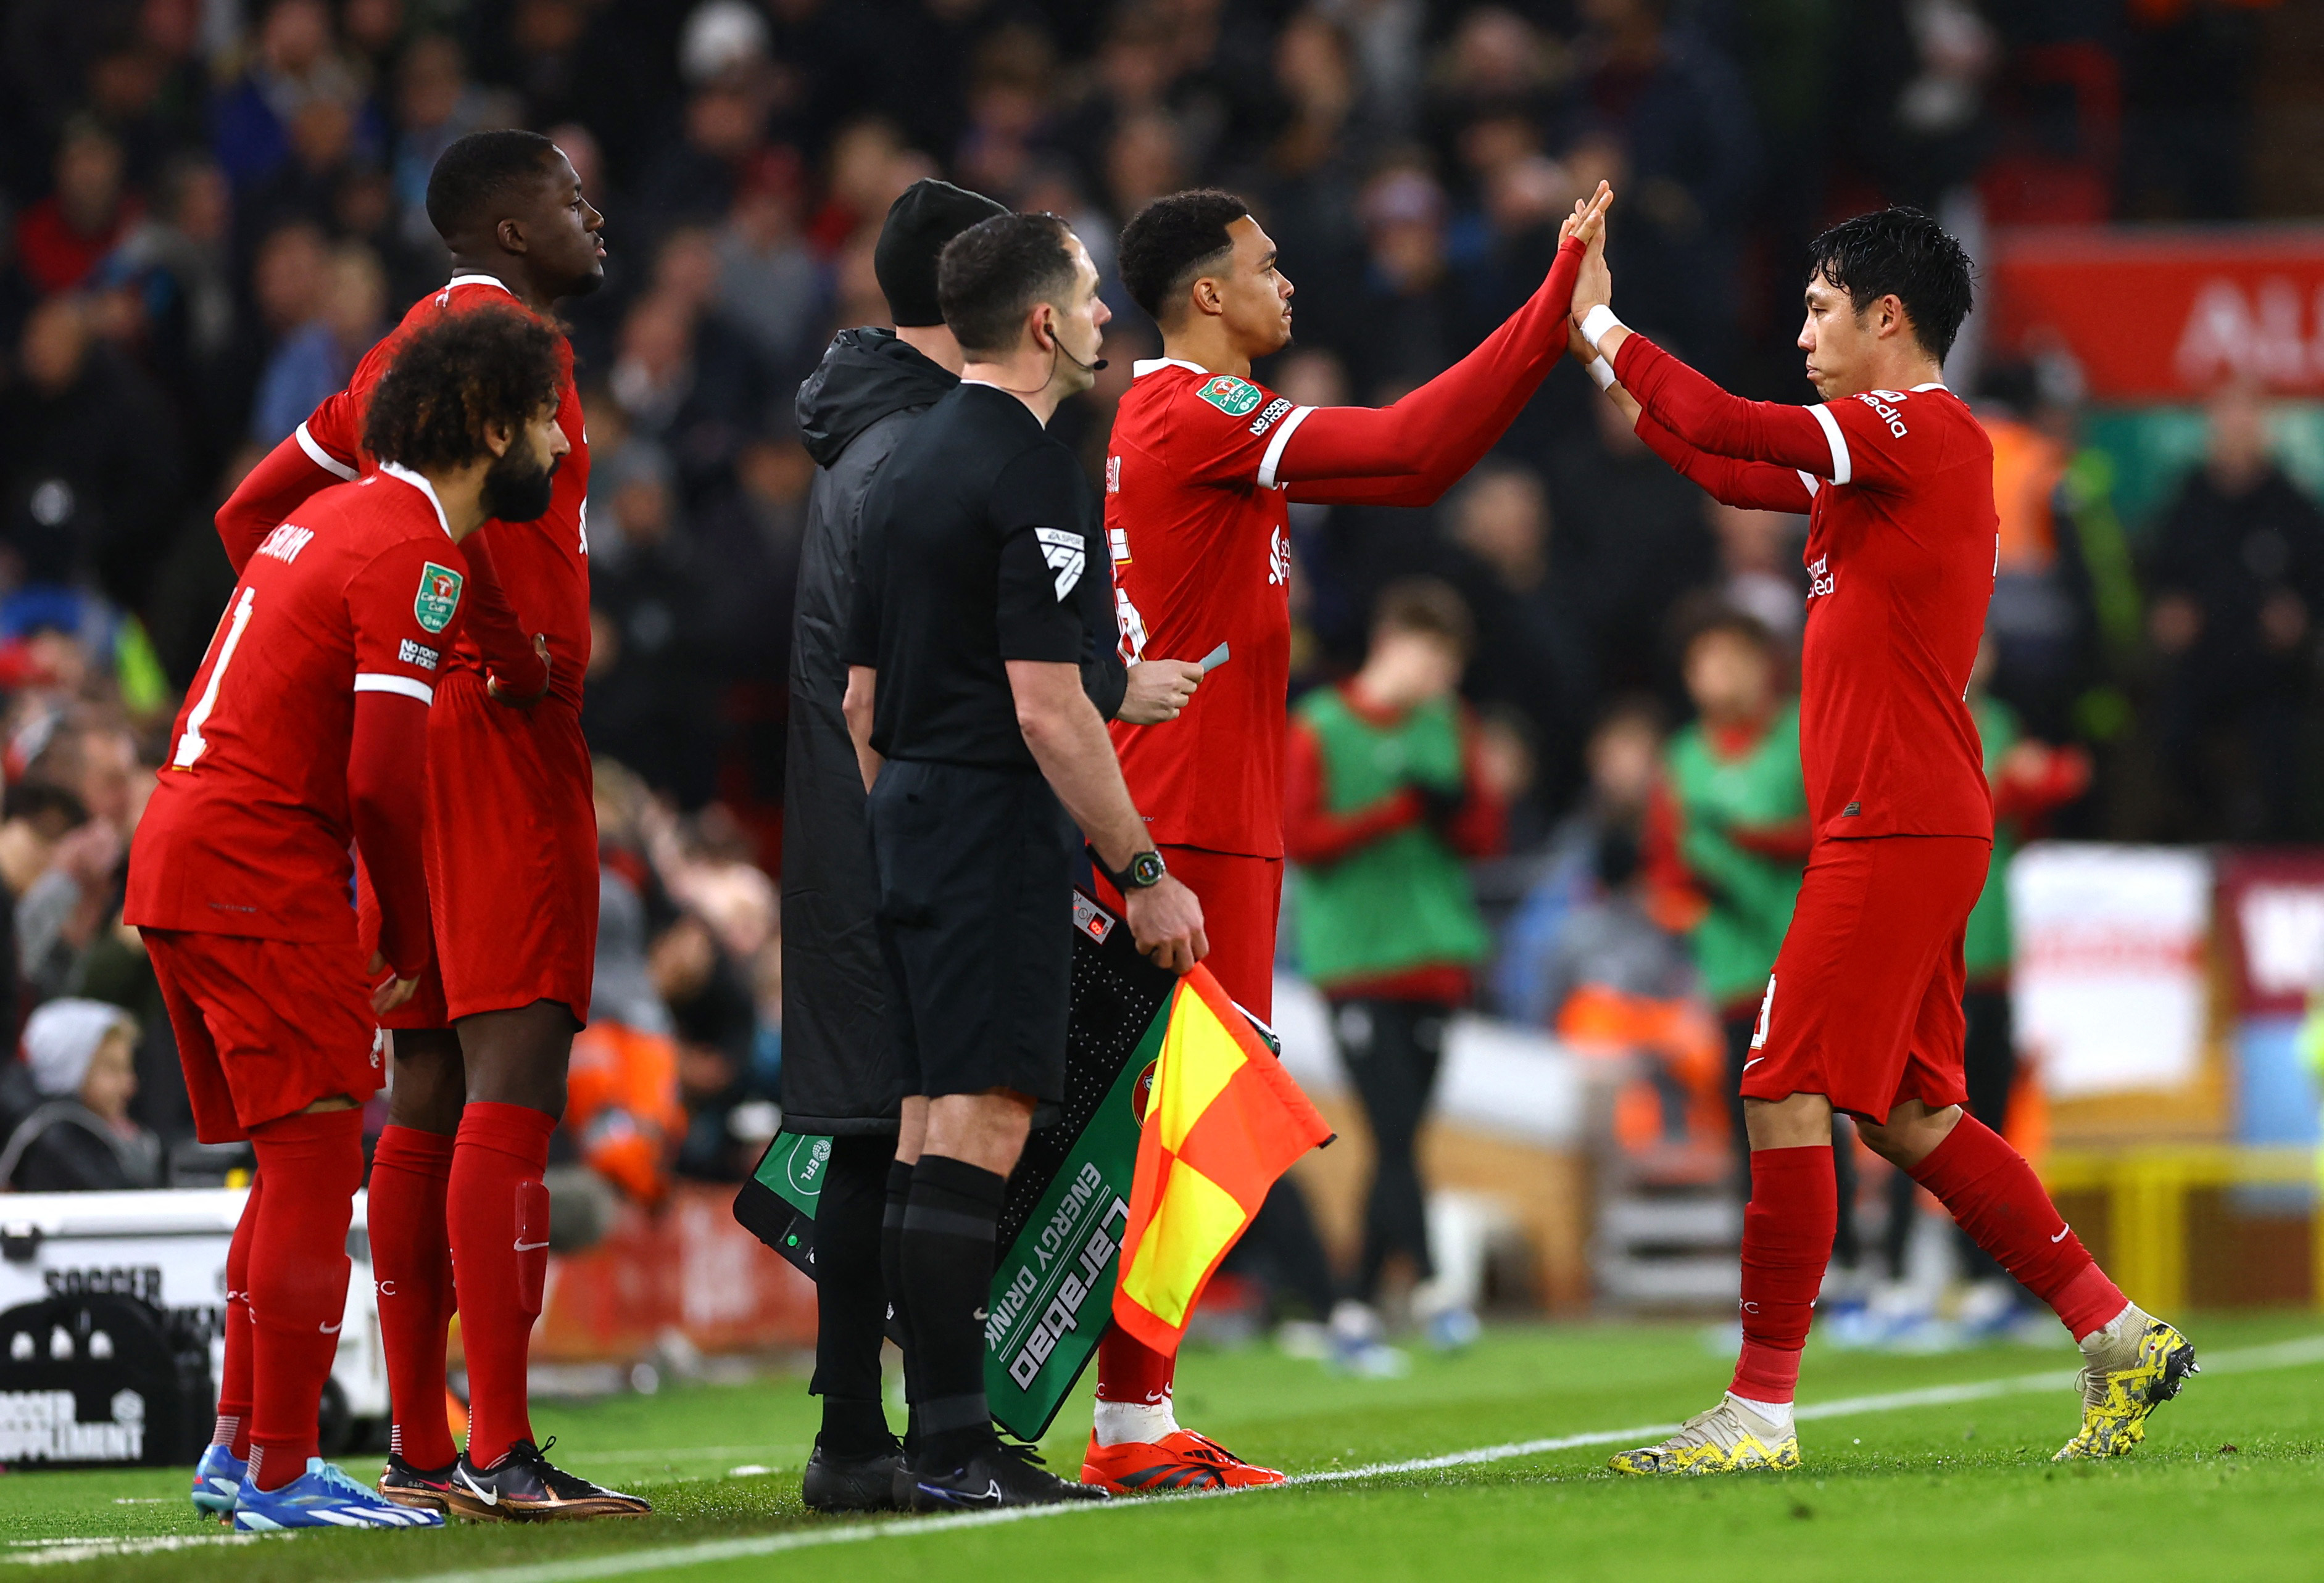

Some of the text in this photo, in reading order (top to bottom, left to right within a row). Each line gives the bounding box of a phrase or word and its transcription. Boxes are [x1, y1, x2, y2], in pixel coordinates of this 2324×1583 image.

[1219, 382, 1245, 407] Carabao
[1230, 389, 1245, 403] Cup
[1249, 418, 1265, 436] No
[401, 639, 419, 653] No
[800, 1158, 820, 1180] EFL
[984, 1162, 1102, 1352] ENERGY DRINK
[1006, 1194, 1130, 1394] Carabao
